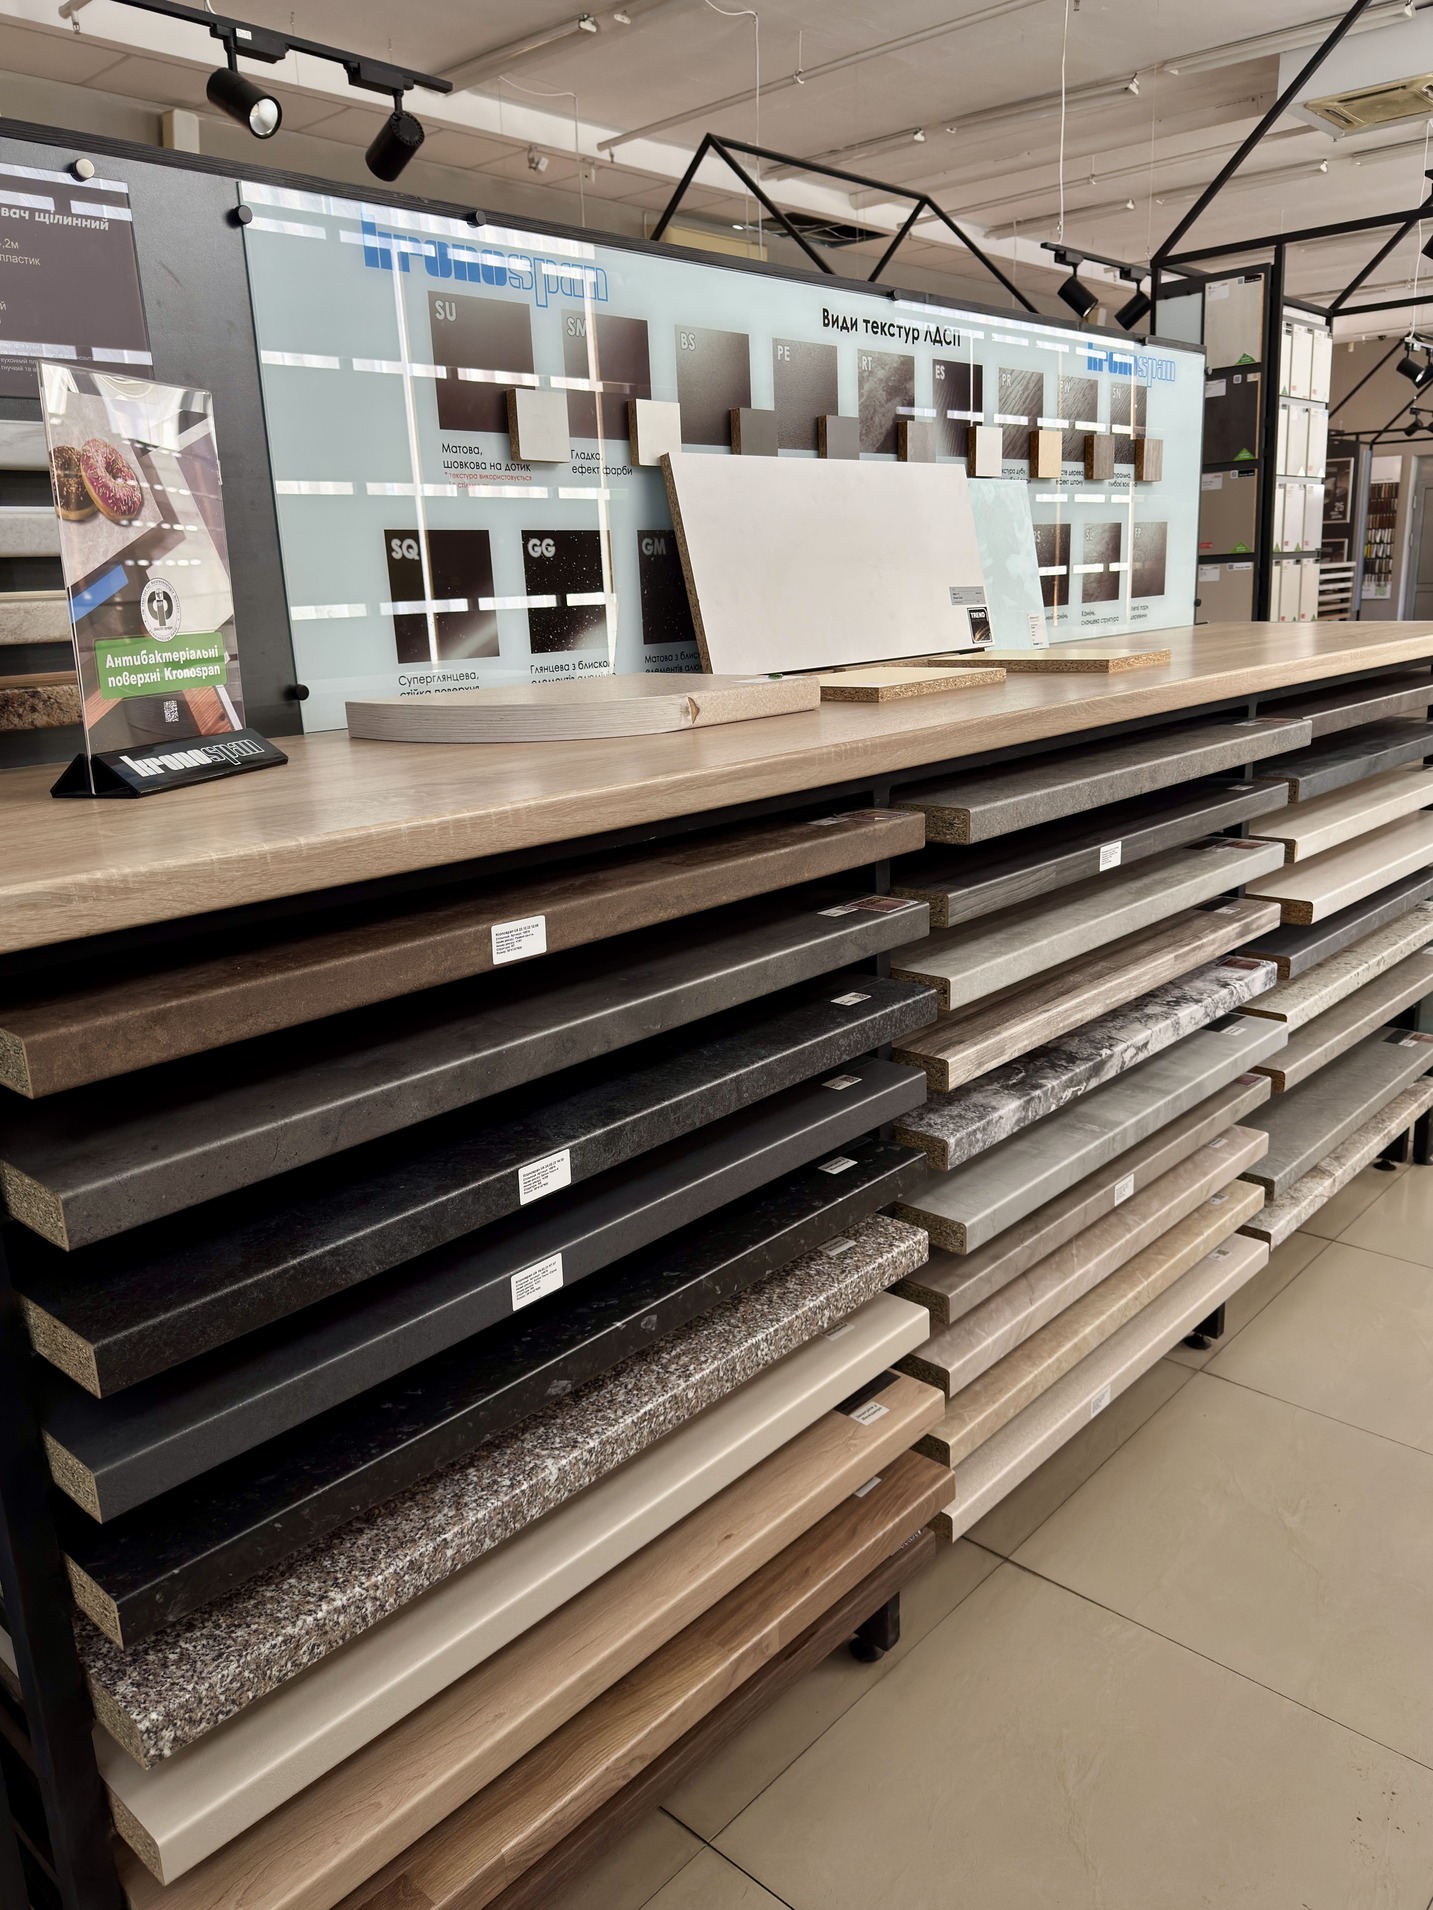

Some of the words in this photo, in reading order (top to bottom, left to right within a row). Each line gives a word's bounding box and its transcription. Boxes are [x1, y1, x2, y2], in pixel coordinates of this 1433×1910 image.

[34, 208, 109, 231] щілинний
[361, 207, 608, 308] kronospan
[434, 300, 457, 322] SU
[822, 307, 858, 333] Види
[862, 318, 920, 345] текстур
[923, 324, 961, 347] ЛДСП
[680, 332, 696, 351] BS
[777, 345, 791, 362] PE
[861, 356, 873, 371] RT
[935, 365, 946, 380] ES
[1001, 373, 1012, 387] PR
[442, 443, 483, 456] Матова,
[443, 460, 487, 470] шовкова
[489, 462, 502, 471] на
[504, 463, 532, 472] дотик
[571, 464, 600, 476] ефект
[602, 465, 633, 477] фарби
[390, 538, 420, 560] SQ
[527, 538, 556, 558] GG
[641, 537, 667, 556] GM
[105, 645, 219, 669] Антибактеріальні
[644, 653, 673, 664] Матова
[107, 668, 161, 687] поверхні
[163, 665, 221, 680] Kronospan
[530, 663, 570, 675] Глянцева
[571, 663, 577, 671] з
[398, 671, 480, 688] Суперглянцева,
[119, 738, 266, 778] kronospan
